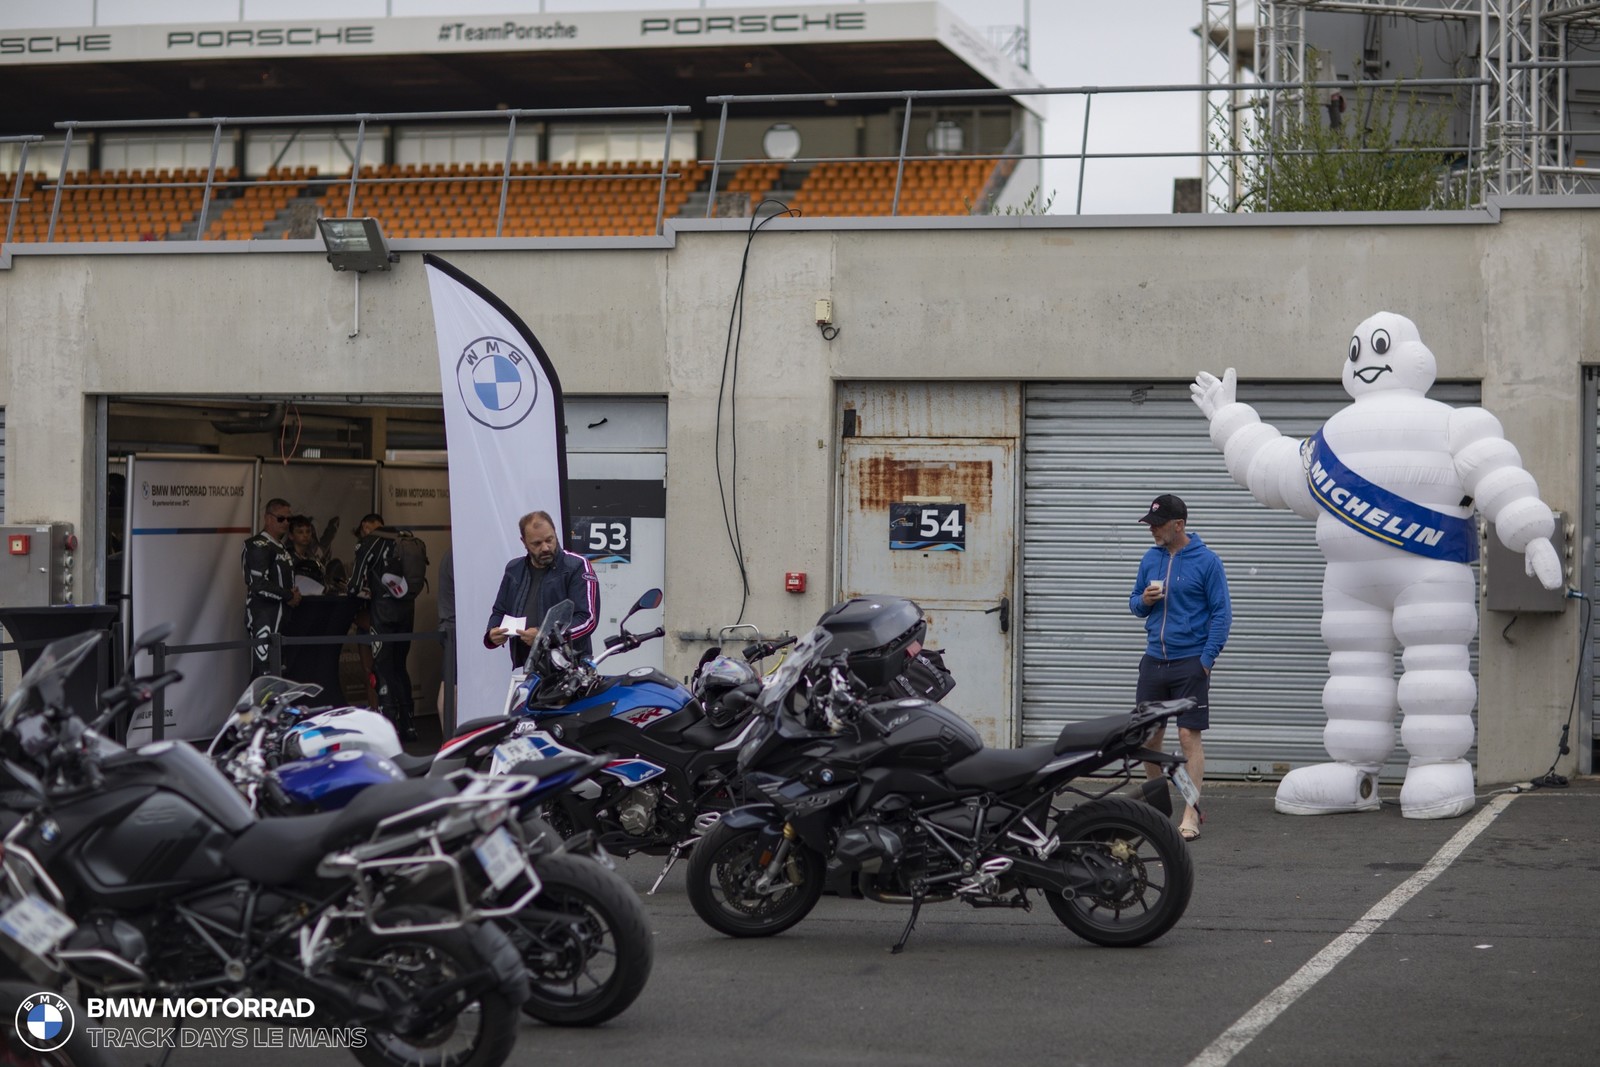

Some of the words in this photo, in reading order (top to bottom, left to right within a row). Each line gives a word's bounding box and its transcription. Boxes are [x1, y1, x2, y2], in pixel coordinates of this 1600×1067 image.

[438, 20, 578, 42] #TeamPorsche
[640, 12, 867, 36] PORSCHE
[0, 34, 112, 54] SCHE
[167, 26, 374, 49] PORSCHE
[151, 485, 169, 497] BMW
[170, 485, 207, 497] MOTORRAD
[209, 486, 229, 497] TRACK
[230, 485, 245, 497] DAYS
[1310, 460, 1445, 547] MICHELIN
[920, 509, 963, 538] 54
[589, 522, 627, 550] 53
